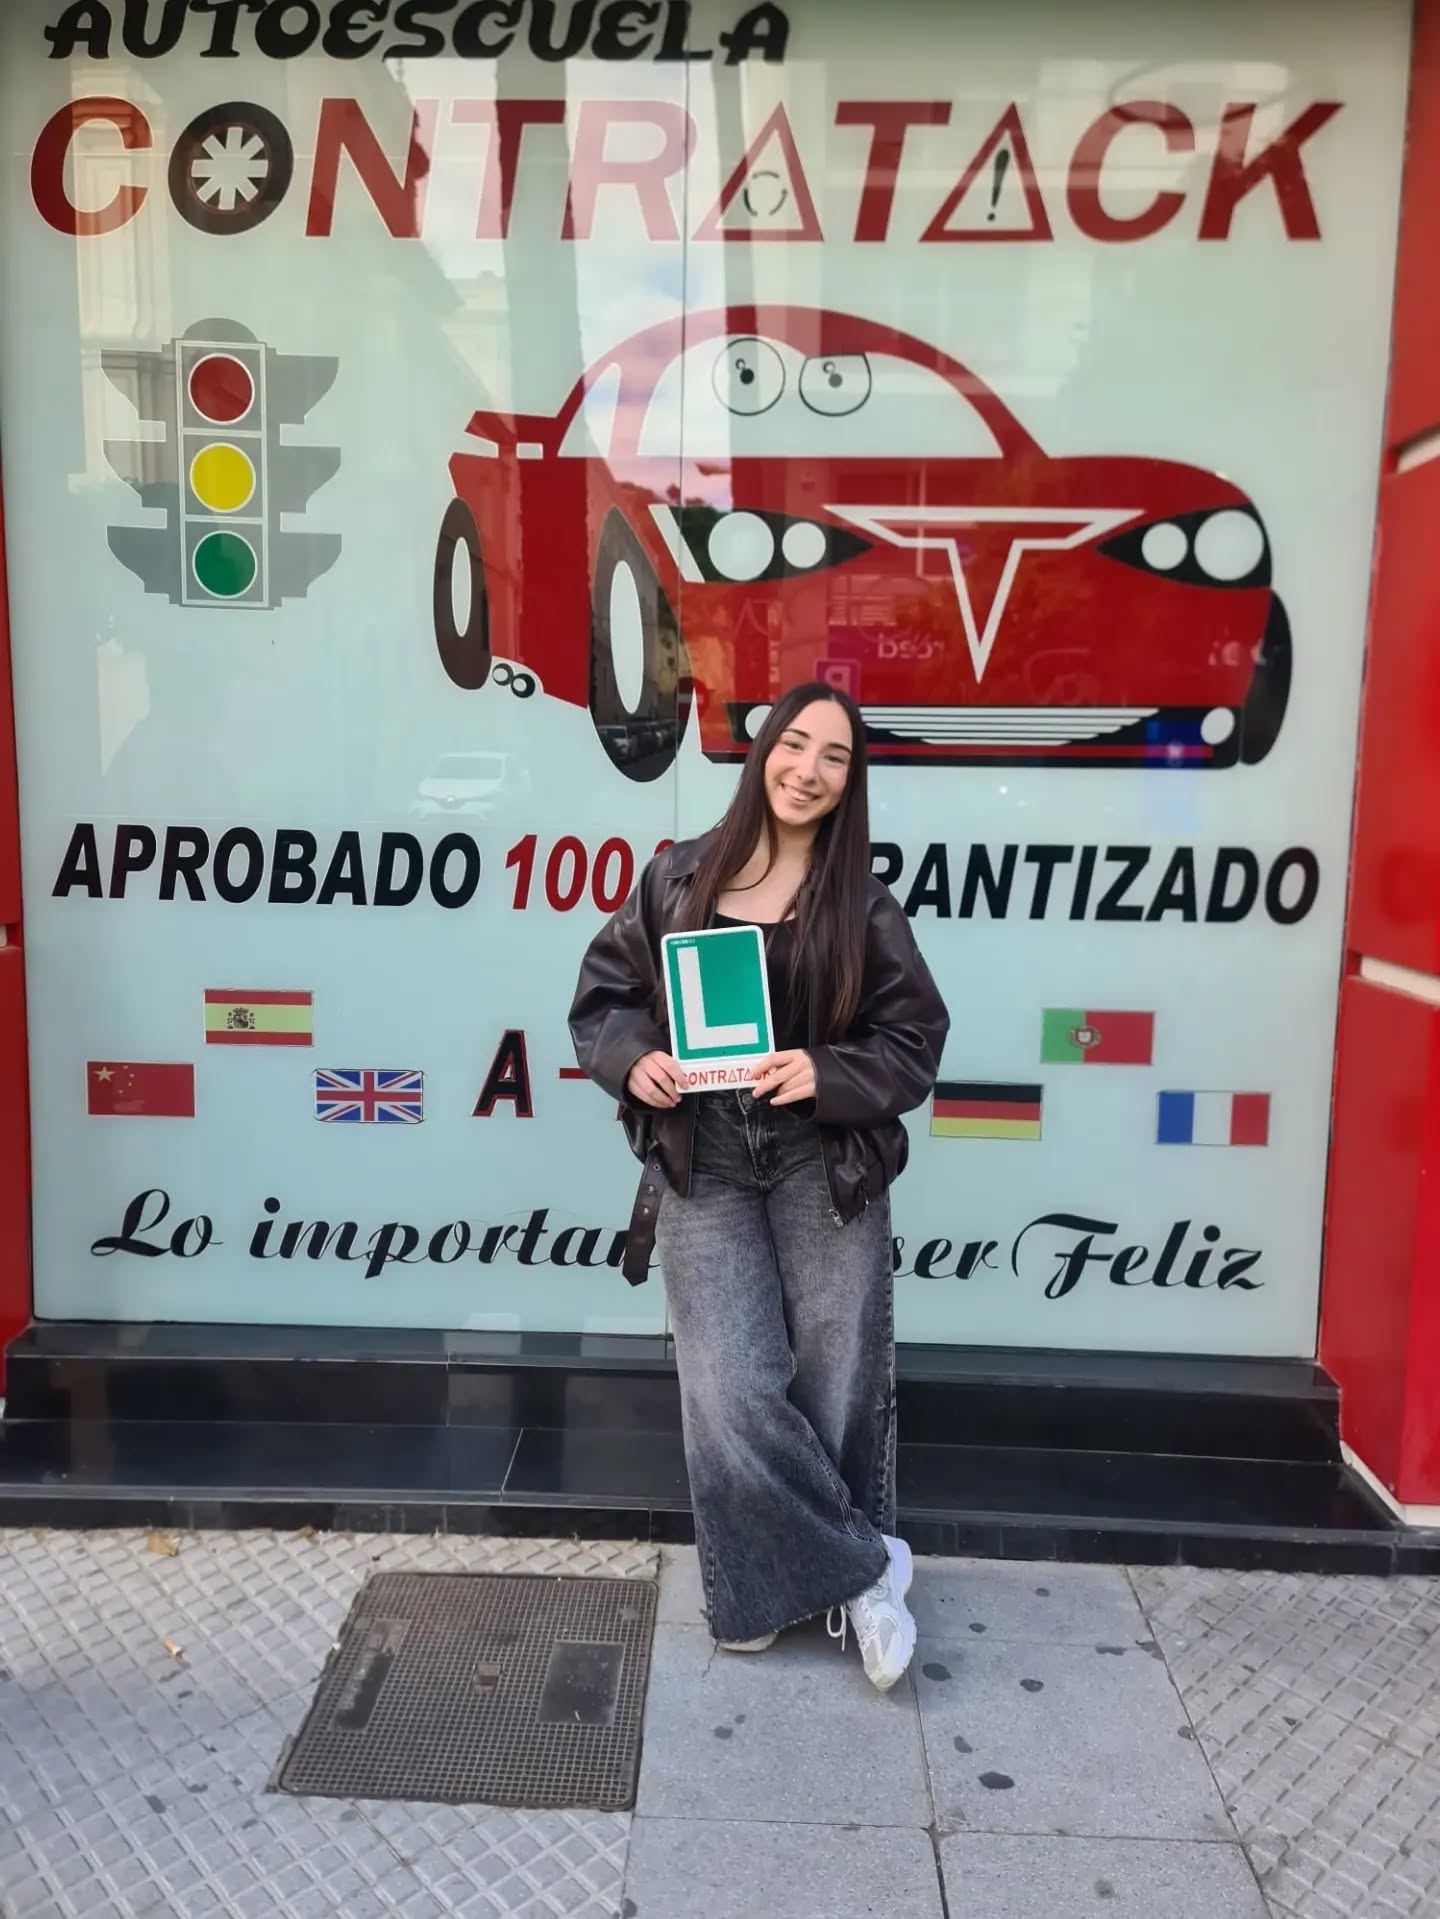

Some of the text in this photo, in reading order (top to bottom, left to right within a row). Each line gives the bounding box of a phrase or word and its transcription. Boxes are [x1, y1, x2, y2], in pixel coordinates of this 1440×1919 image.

[45, 0, 790, 65] AUTOESCUELA
[52, 823, 481, 909] APROBADO
[677, 946, 759, 1049] L
[472, 1029, 533, 1118] A
[684, 1067, 769, 1086] ONTRATA
[91, 1188, 223, 1257] Lo
[1011, 1213, 1265, 1299] Feliz
